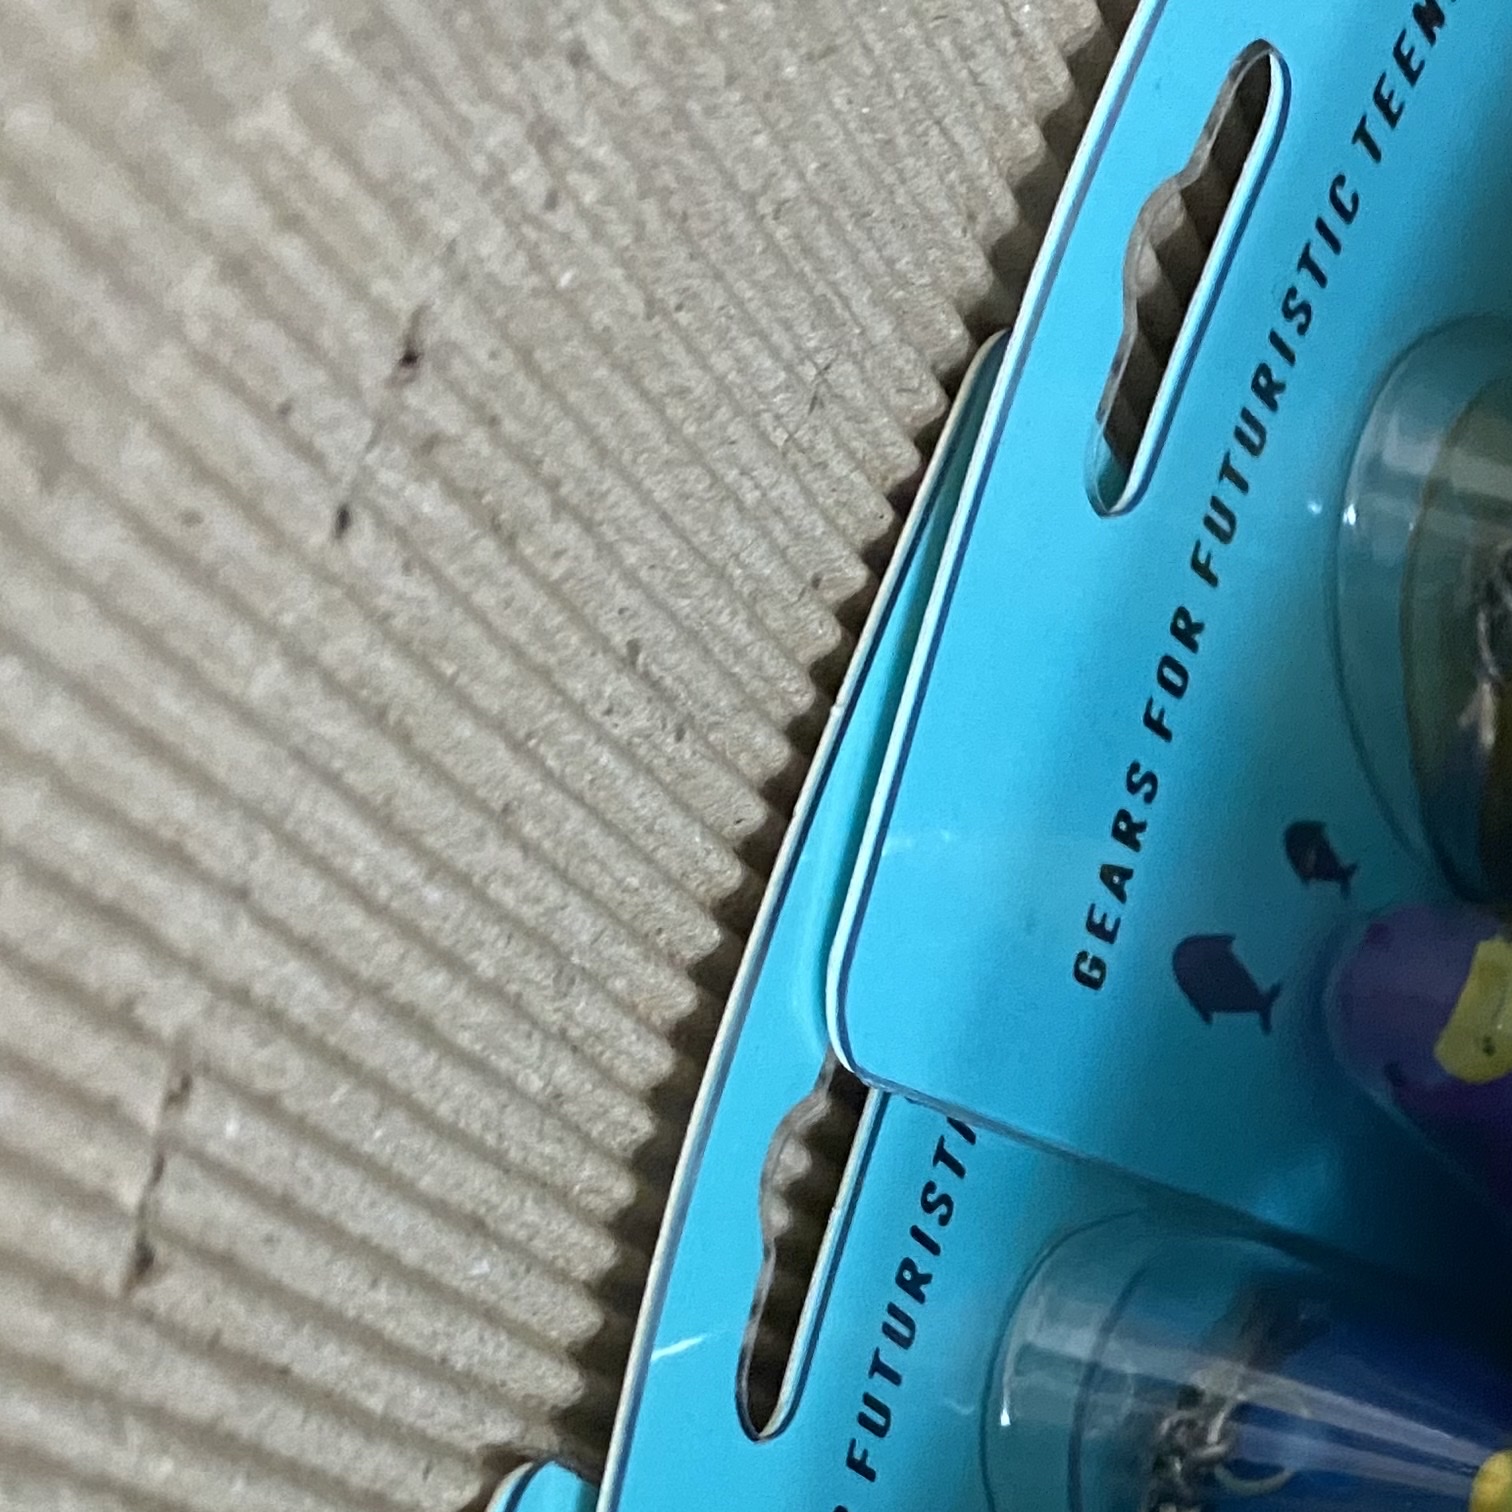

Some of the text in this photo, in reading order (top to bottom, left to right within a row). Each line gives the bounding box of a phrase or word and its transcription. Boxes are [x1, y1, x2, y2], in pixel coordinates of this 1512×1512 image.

[1073, 760, 1159, 991] GEARS
[1142, 605, 1205, 743] FOR
[1189, 172, 1361, 588] FUTURISTIC
